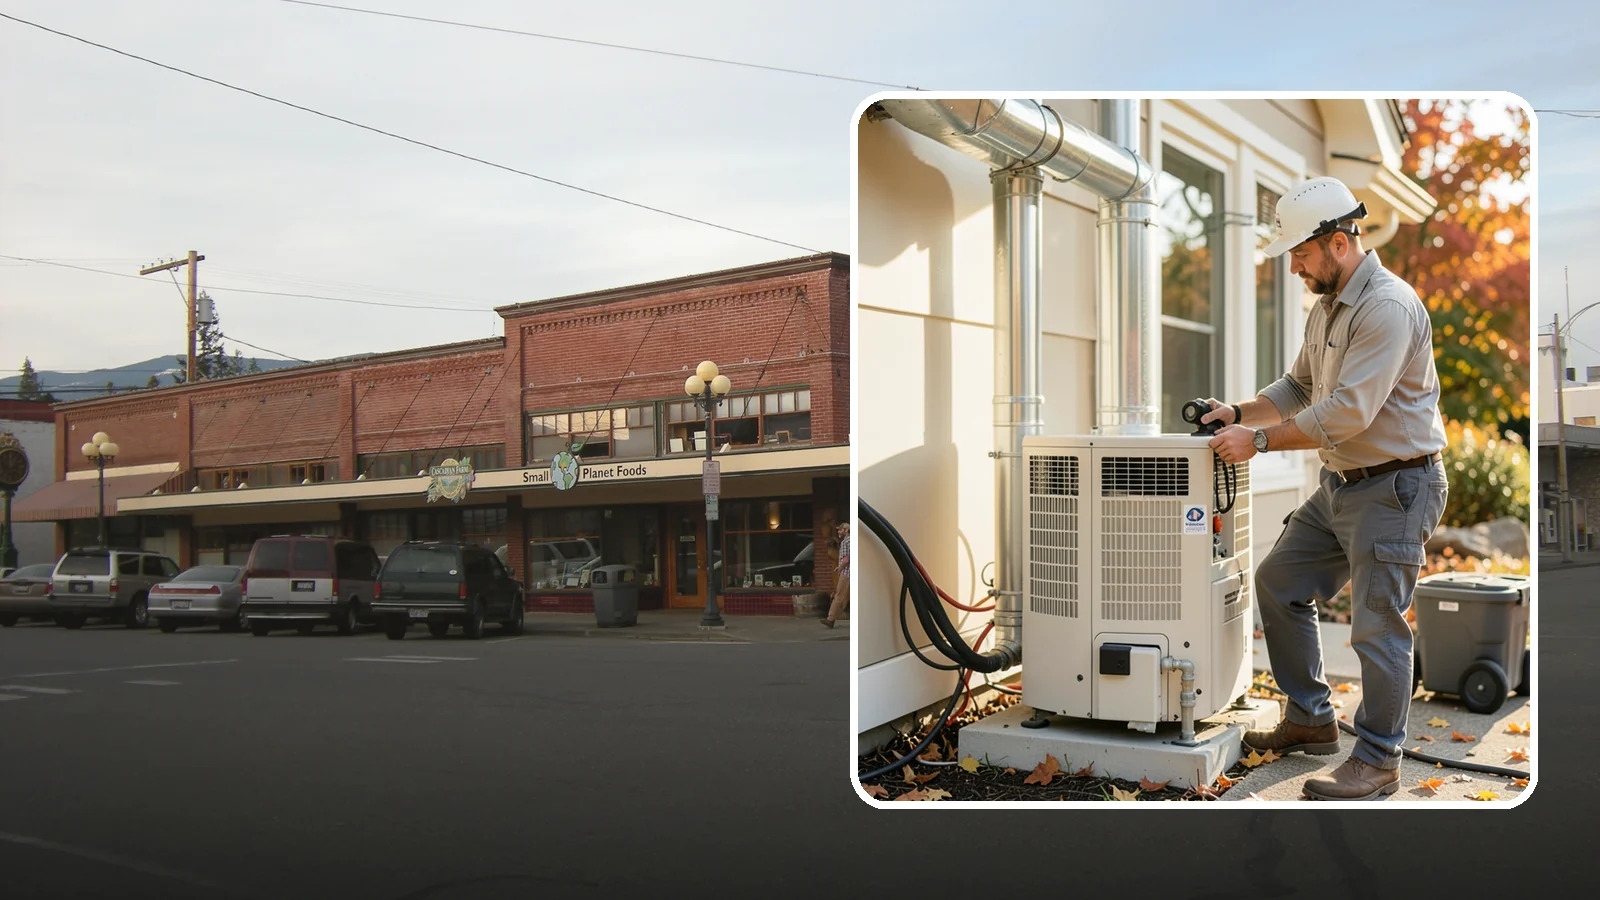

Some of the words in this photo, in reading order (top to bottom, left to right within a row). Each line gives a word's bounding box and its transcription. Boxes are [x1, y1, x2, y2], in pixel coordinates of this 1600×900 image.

[523, 471, 549, 483] Small
[582, 468, 614, 479] Planet
[617, 464, 647, 477] Foods
